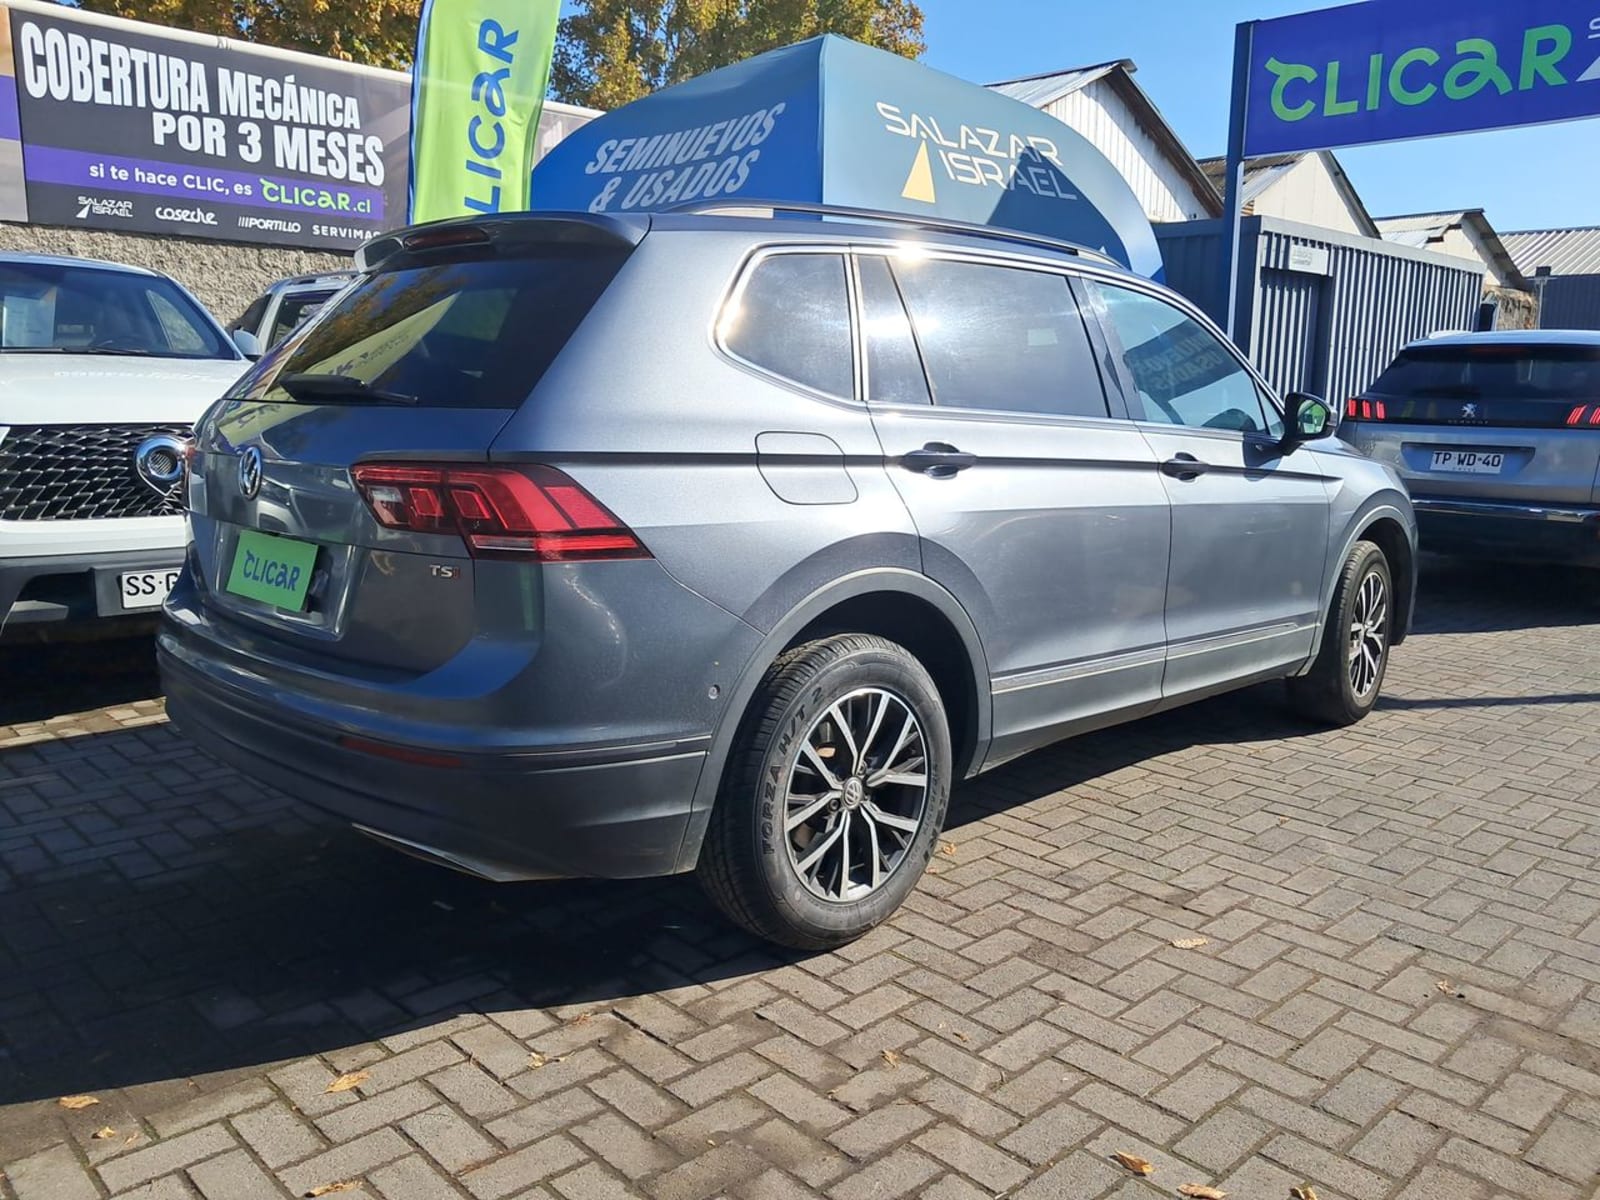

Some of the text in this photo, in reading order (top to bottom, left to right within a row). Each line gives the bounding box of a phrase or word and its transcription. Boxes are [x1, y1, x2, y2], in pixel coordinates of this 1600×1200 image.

[20, 21, 361, 130] COBERTURA MECÁNICA
[152, 112, 385, 187] POR 3 MESES
[585, 102, 786, 175] SEMINUEVOS
[876, 101, 1064, 167] SALAZAR
[78, 195, 133, 210] SALAZAR
[89, 163, 105, 178] si
[110, 165, 129, 180] te
[134, 167, 178, 186] hace
[183, 174, 229, 196] CLIC,
[233, 182, 253, 196] es
[588, 149, 761, 213] & USADOS
[938, 150, 1078, 200] ISRAEL
[92, 205, 134, 218] ISRAEL
[761, 765, 783, 855] FORZA
